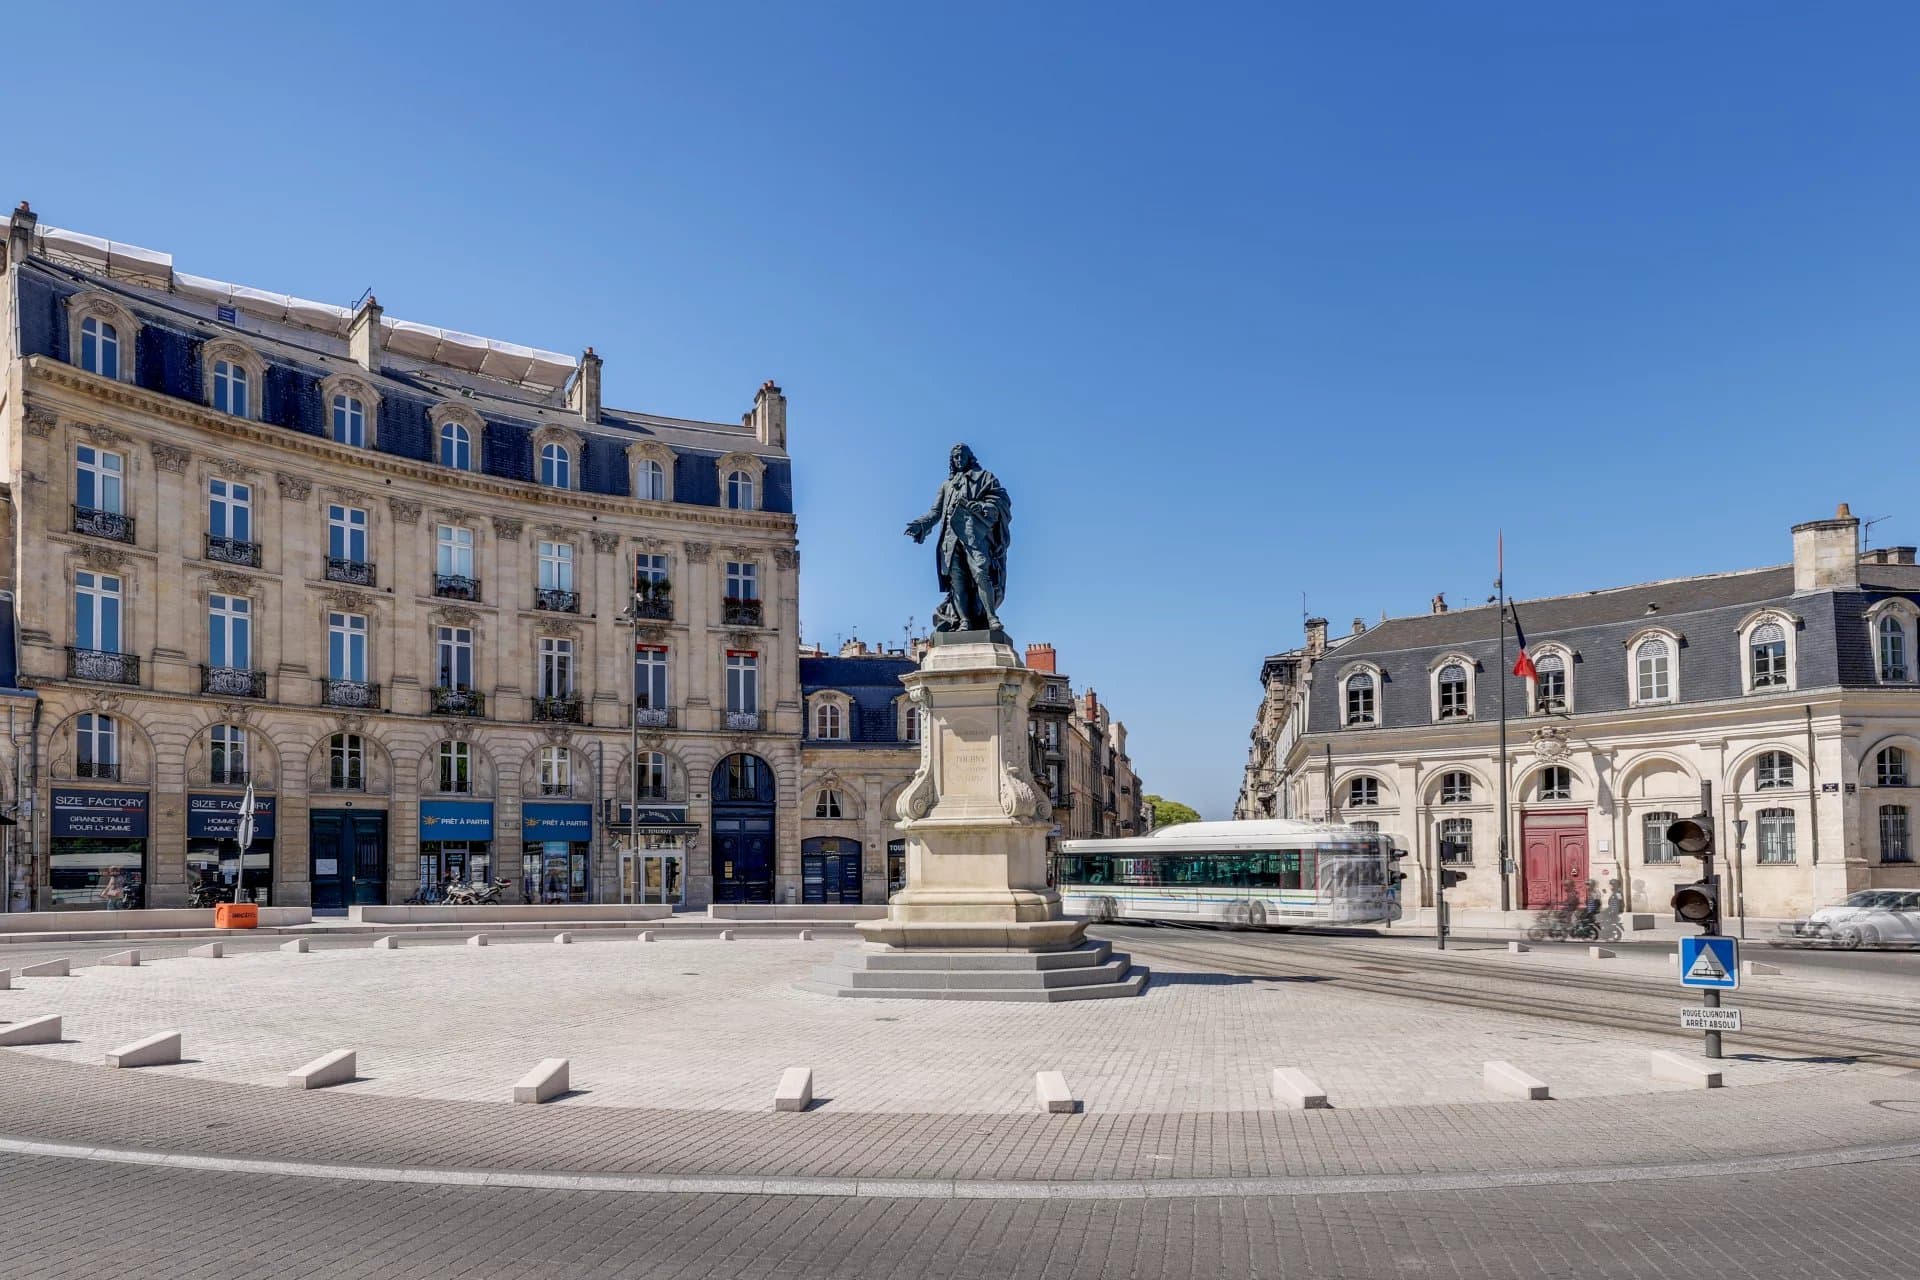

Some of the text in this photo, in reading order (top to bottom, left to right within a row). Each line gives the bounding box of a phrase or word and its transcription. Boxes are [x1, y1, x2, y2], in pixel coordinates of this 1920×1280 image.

[55, 796, 144, 807] SIZE FACTORY
[191, 799, 271, 810] SIZE FACRY
[70, 815, 131, 824] GRANDE TAILLE
[441, 817, 458, 825] PRÊT
[1682, 1009, 1737, 1019] ROUGE CLIGNOTANT
[1686, 1018, 1736, 1029] ARRÊT ABSOLU
